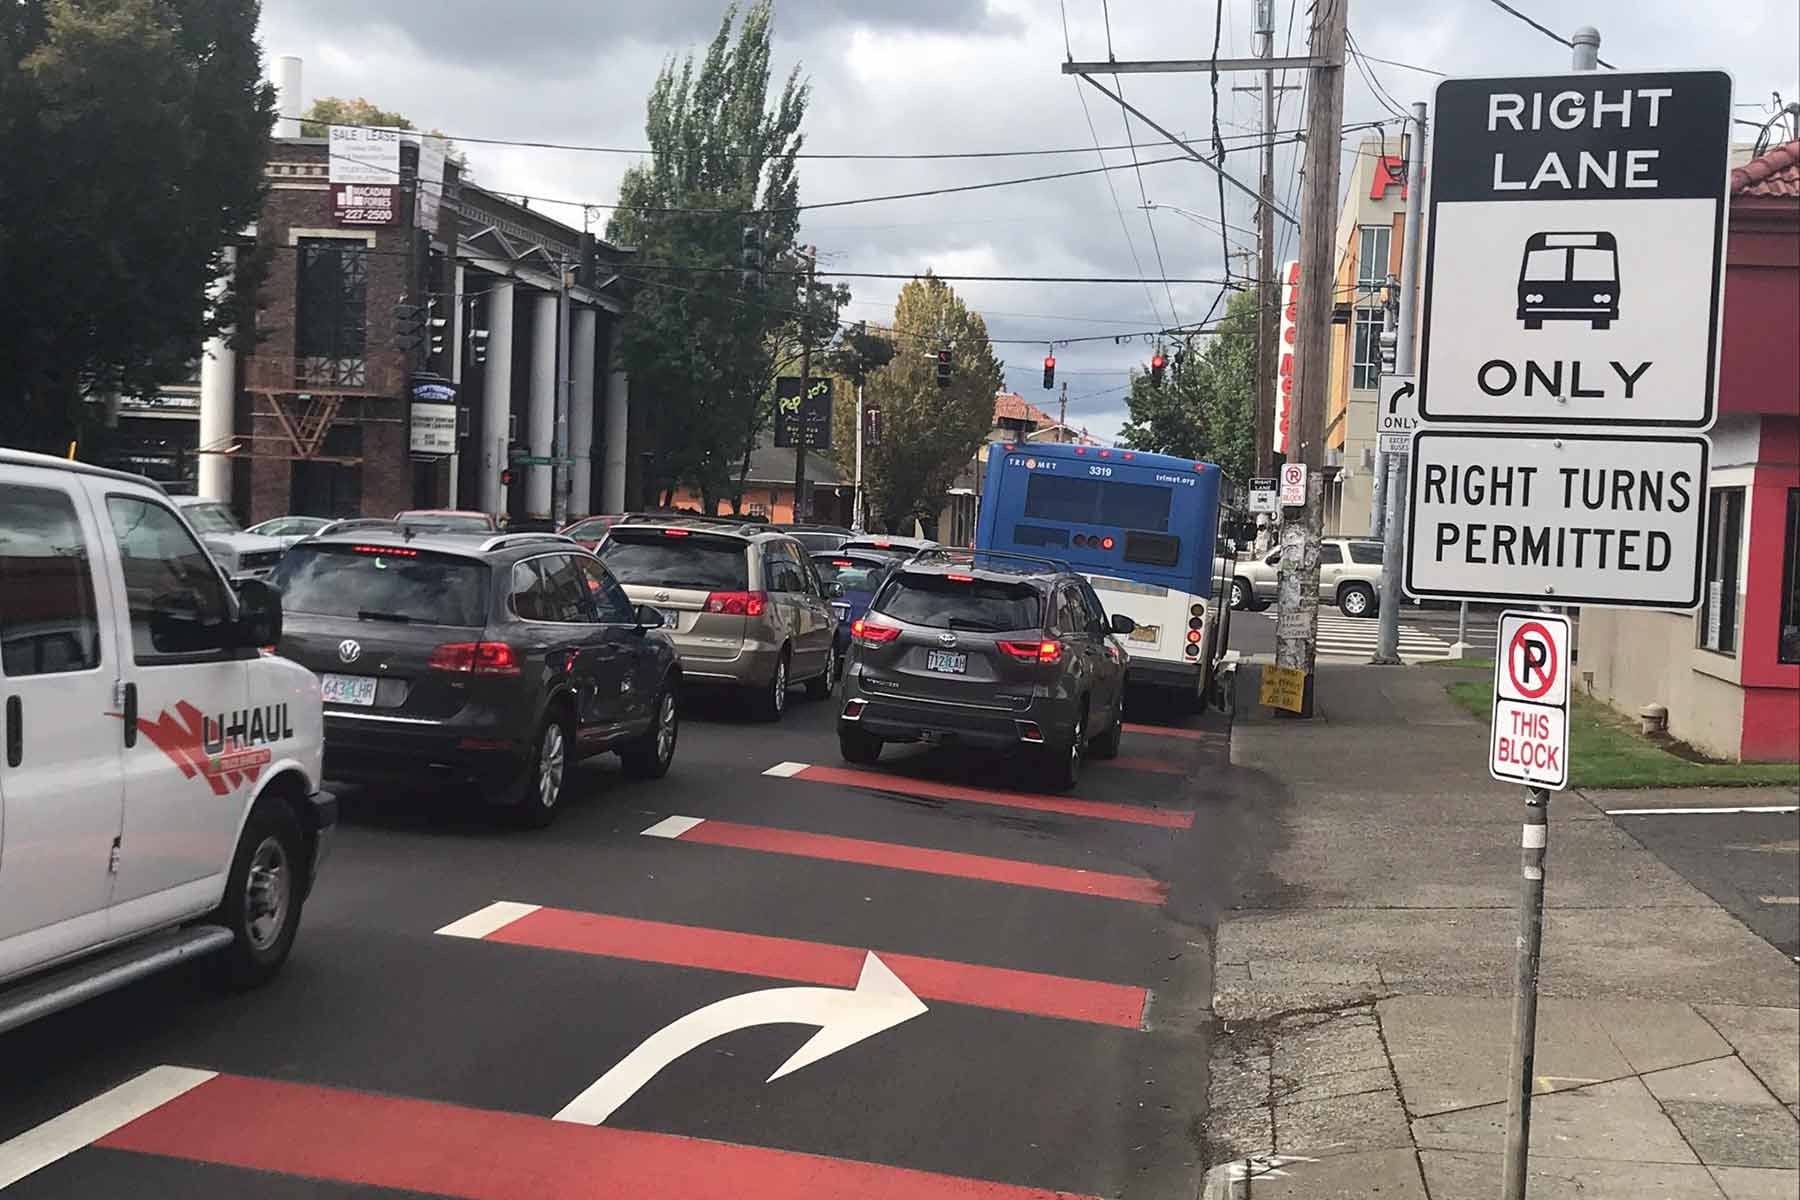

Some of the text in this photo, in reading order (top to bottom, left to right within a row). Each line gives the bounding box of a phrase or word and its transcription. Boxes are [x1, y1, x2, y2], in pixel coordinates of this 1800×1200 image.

[1487, 88, 1673, 131] RIGHT
[332, 129, 398, 142] SALE LEASE
[1493, 150, 1660, 190] LANE
[1477, 359, 1653, 399] ONLY
[1384, 416, 1418, 429] ONLY
[1088, 465, 1112, 477] 3319
[1155, 474, 1196, 486] trimet.org
[1424, 464, 1692, 513] RIGHT TURNS
[1435, 522, 1672, 572] PERMITTED
[324, 680, 345, 696] 643
[203, 702, 294, 755] U-HAUL
[1511, 711, 1549, 739] THIS
[1498, 737, 1560, 772] BLOCK
